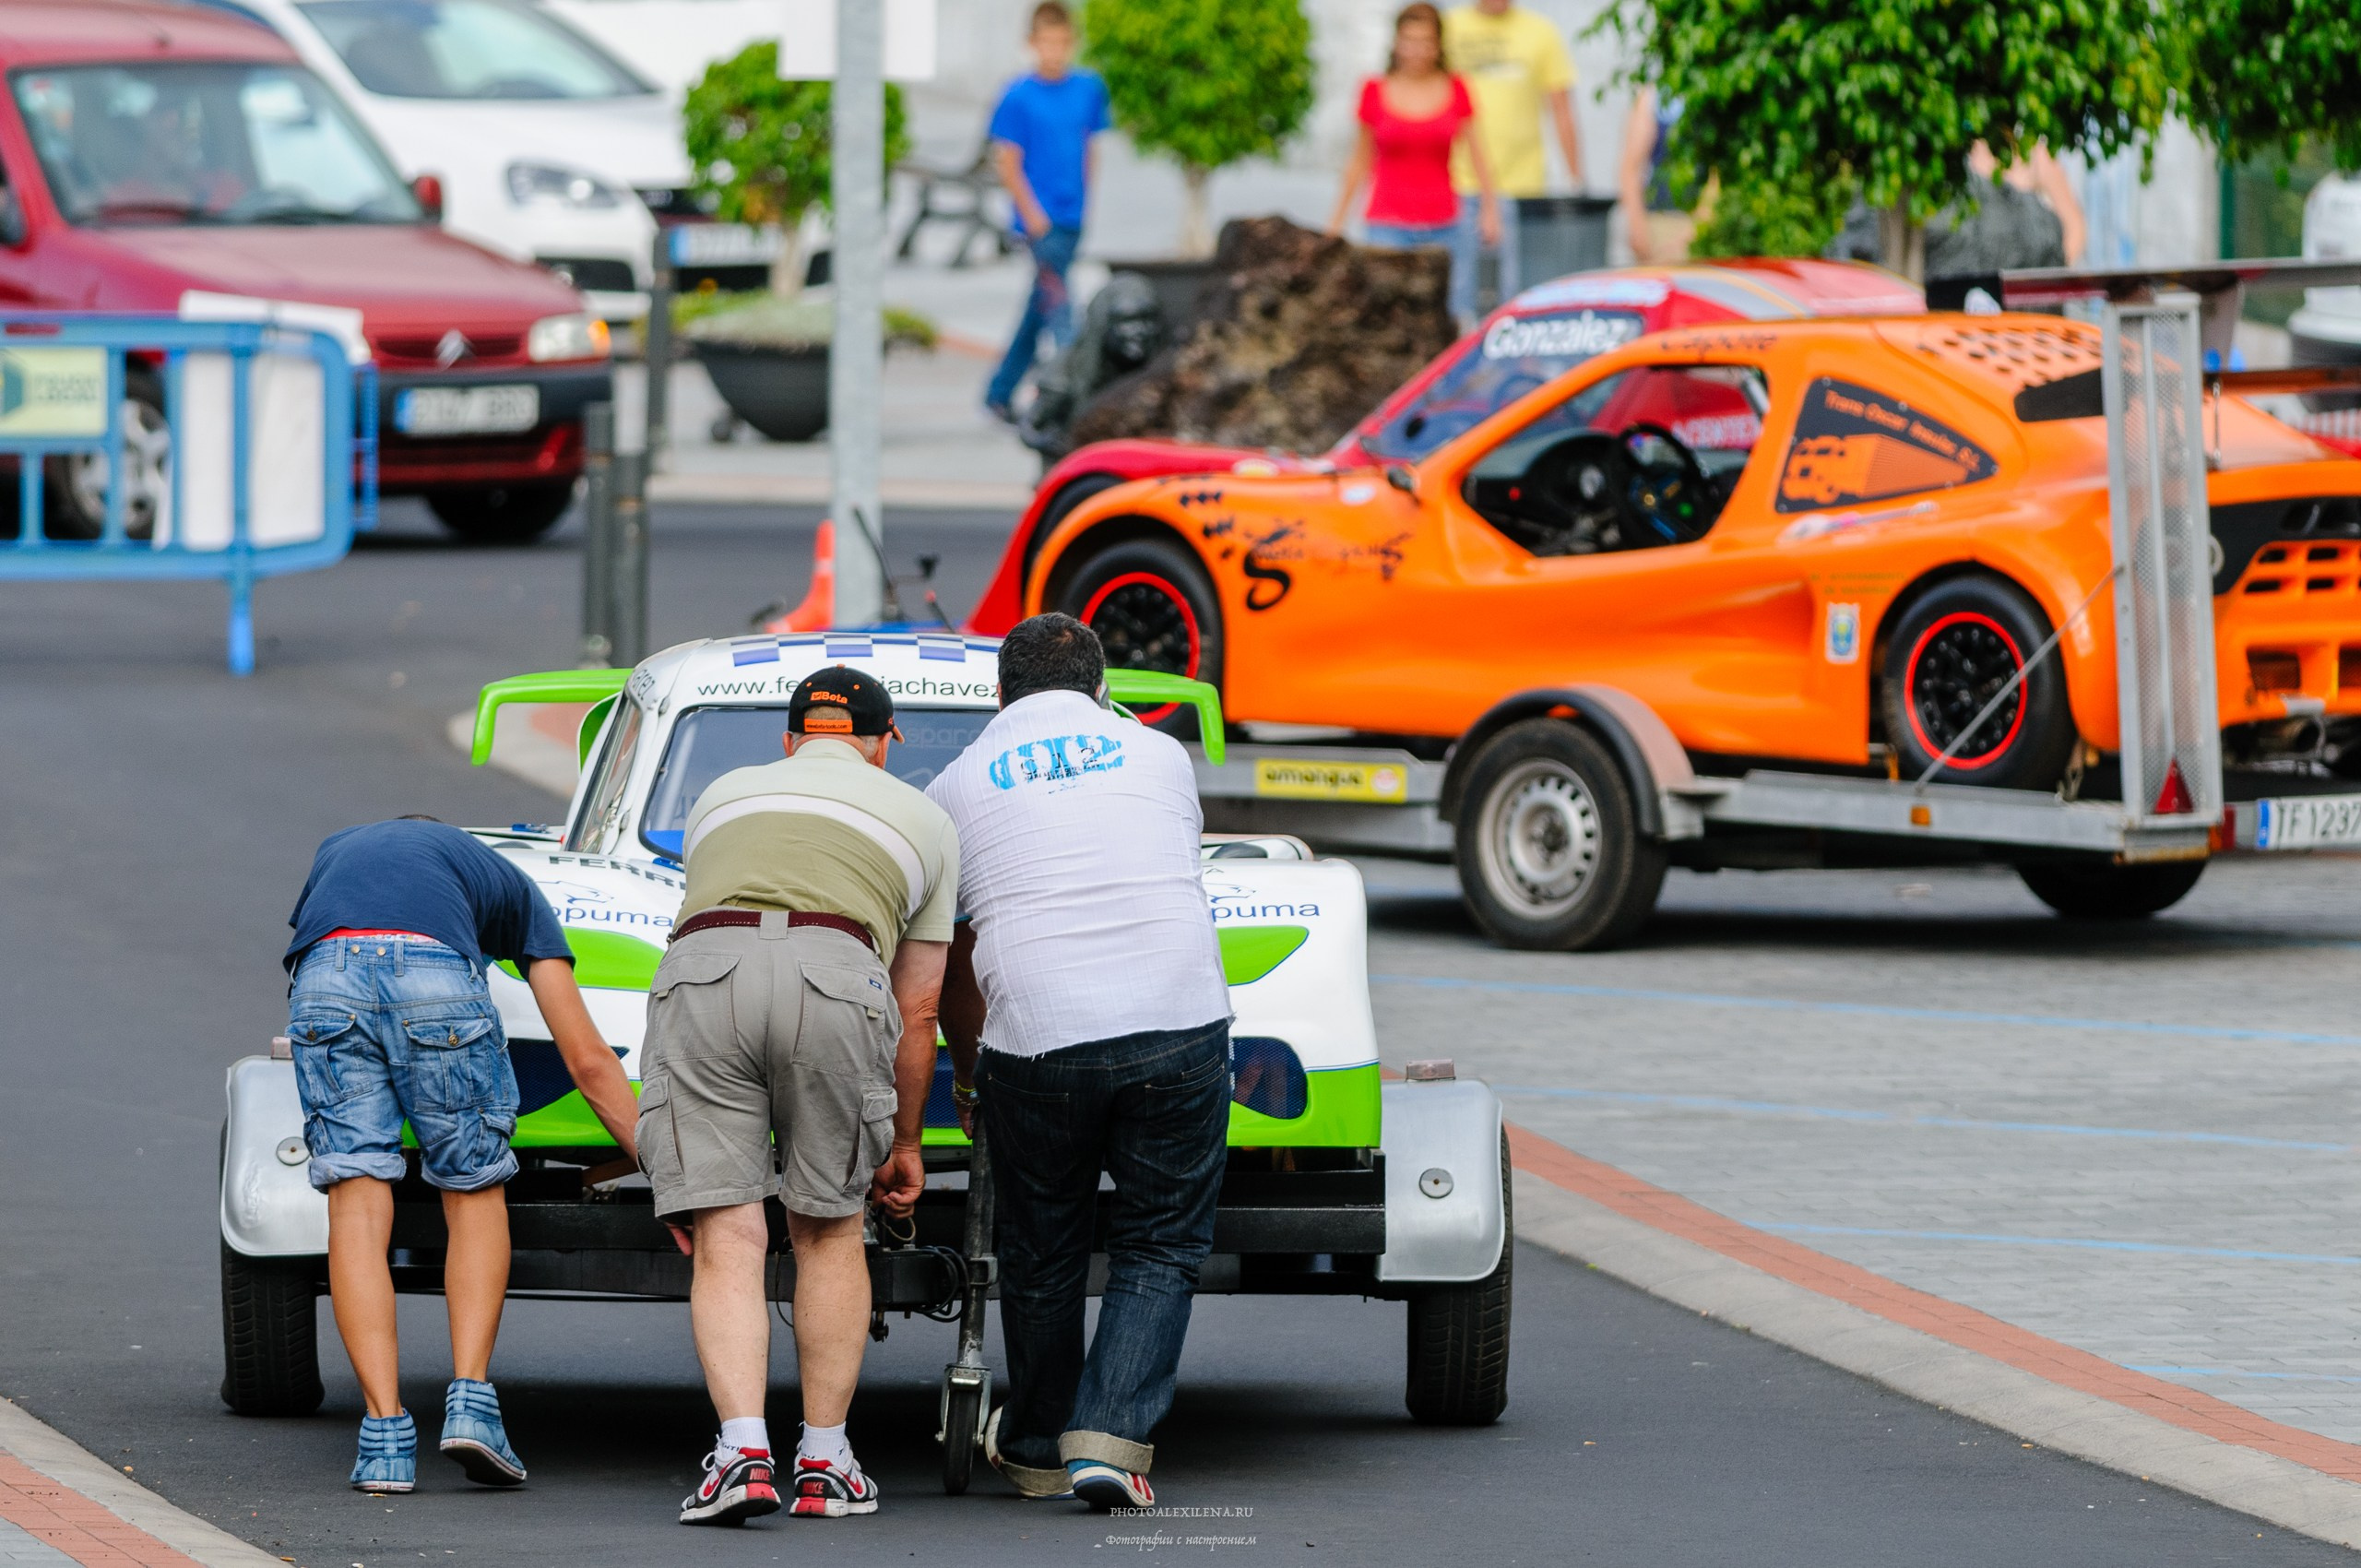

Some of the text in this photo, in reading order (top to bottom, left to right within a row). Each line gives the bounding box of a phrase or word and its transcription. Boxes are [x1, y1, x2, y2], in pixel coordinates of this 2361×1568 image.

[1825, 388, 1865, 418] Trans
[1865, 403, 1909, 432] Oscar
[549, 856, 685, 890] FERR
[1211, 904, 1320, 923] puma
[749, 1467, 770, 1481] NIKE
[802, 1481, 825, 1495] NIKE
